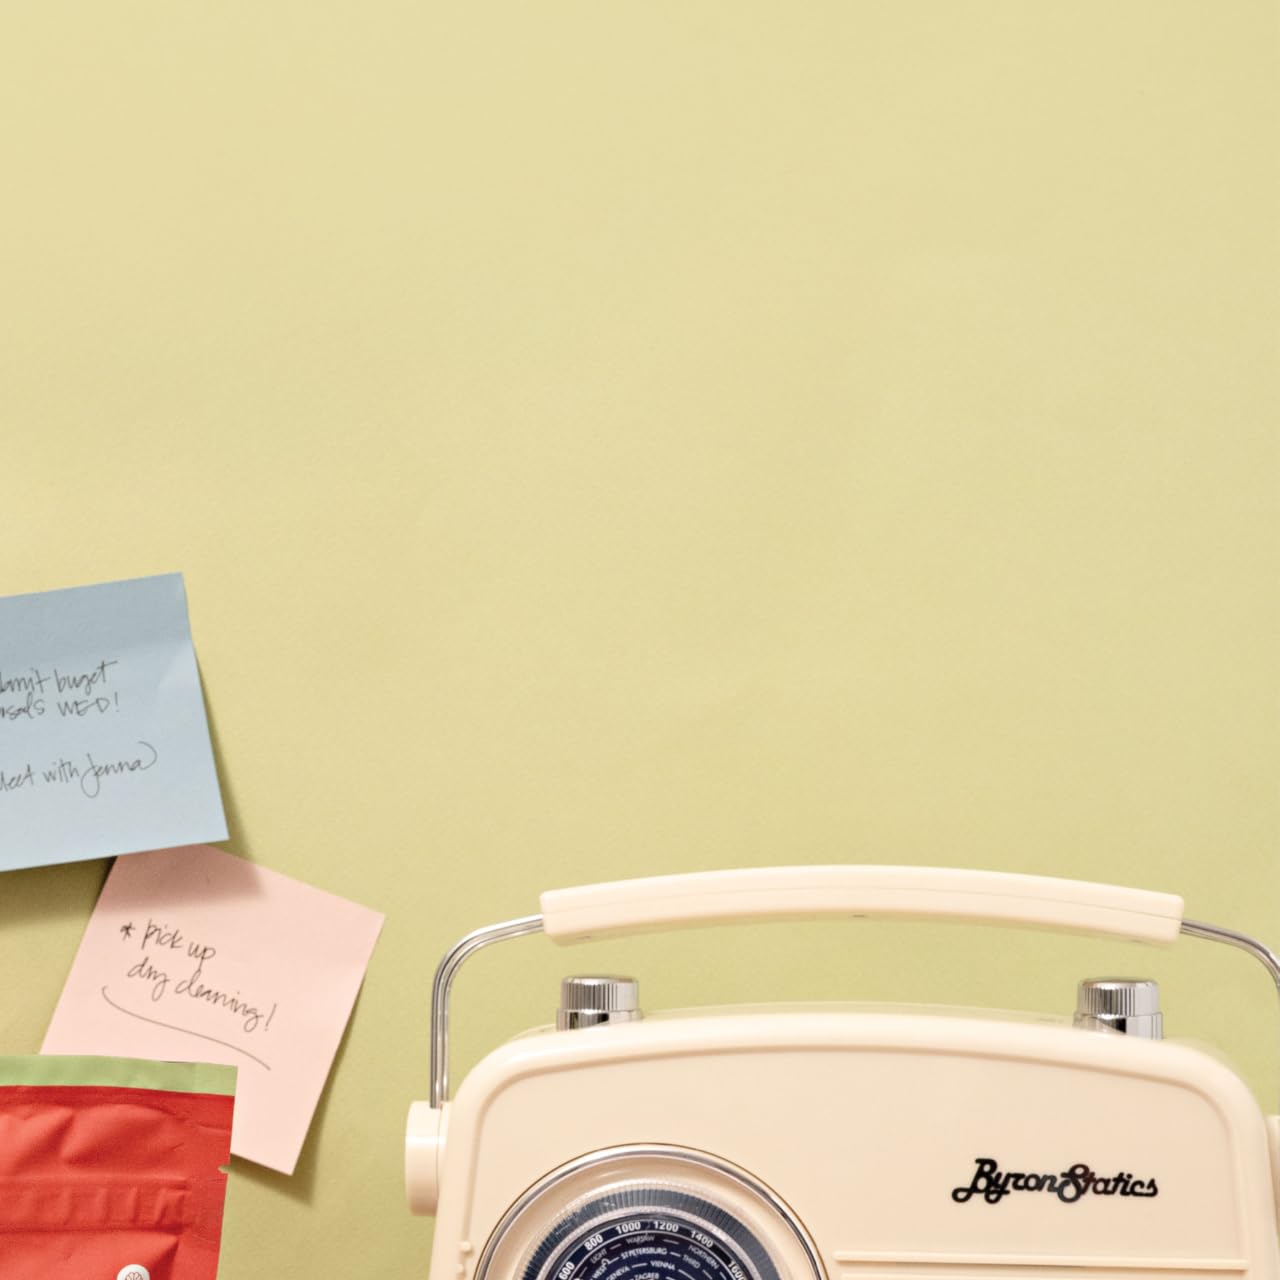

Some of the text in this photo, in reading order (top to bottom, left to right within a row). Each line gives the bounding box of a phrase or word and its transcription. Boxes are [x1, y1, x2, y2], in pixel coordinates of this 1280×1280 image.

[54, 660, 118, 696] buget
[57, 691, 120, 717] WED!
[43, 758, 80, 784] with
[81, 741, 158, 798] Jenna
[141, 918, 216, 971] pick up
[127, 956, 277, 1033] dry cleaning!
[558, 1261, 575, 1280] 600
[583, 1234, 604, 1251] 800
[615, 1221, 641, 1235] 1000
[653, 1220, 679, 1233] 1200
[690, 1230, 714, 1249] 1400
